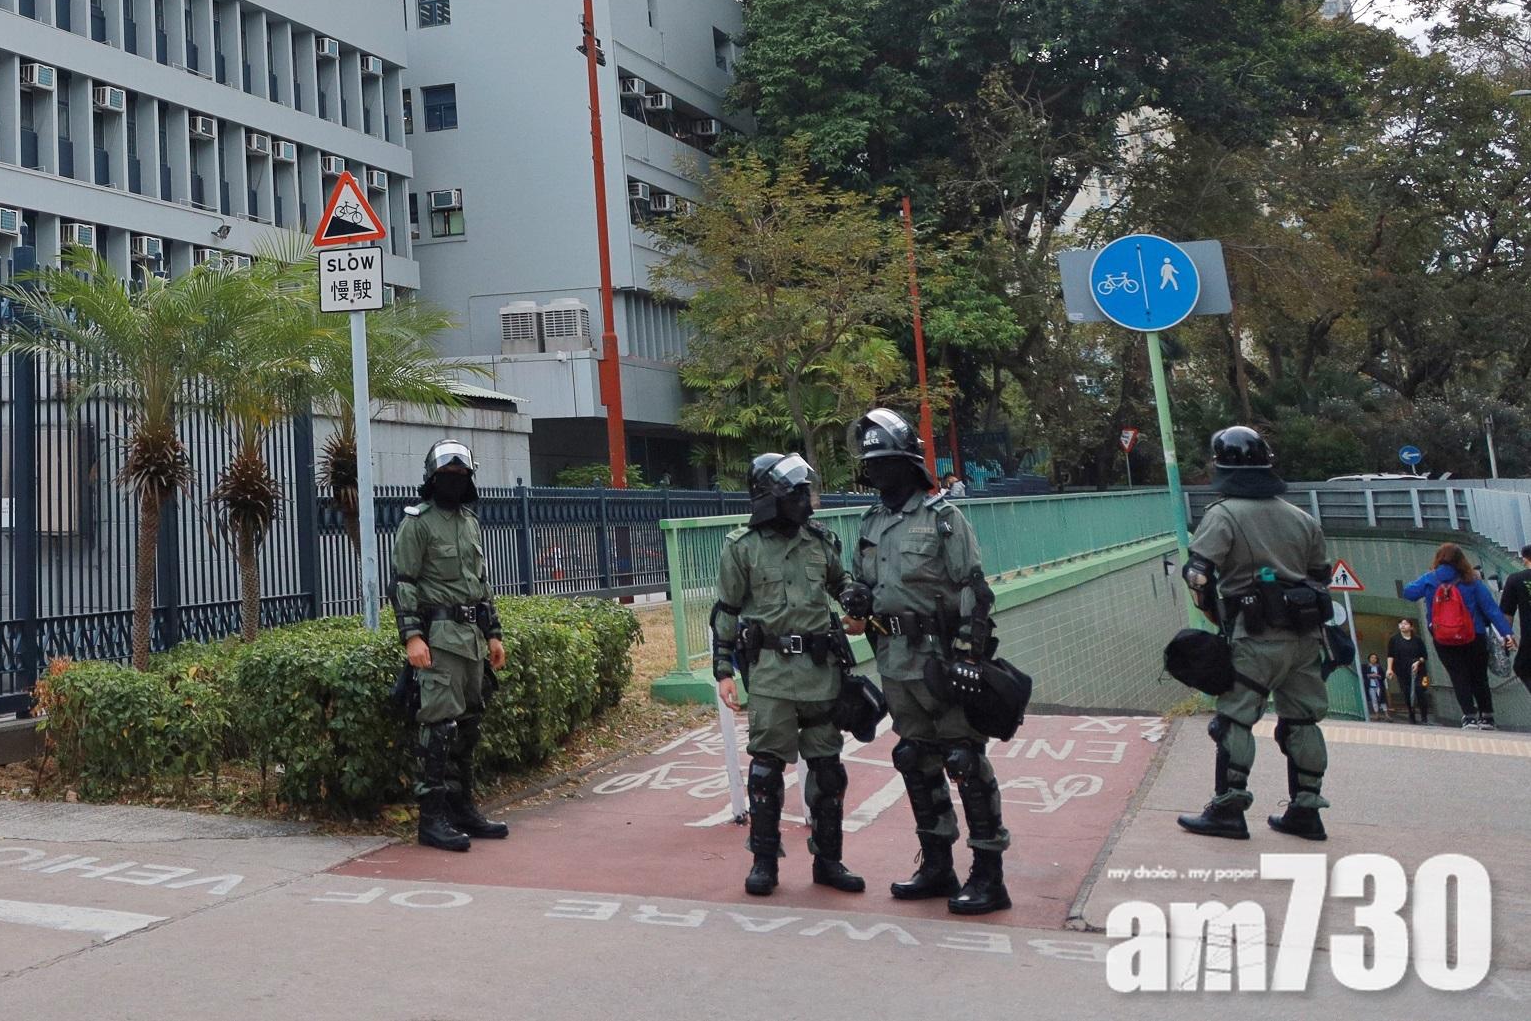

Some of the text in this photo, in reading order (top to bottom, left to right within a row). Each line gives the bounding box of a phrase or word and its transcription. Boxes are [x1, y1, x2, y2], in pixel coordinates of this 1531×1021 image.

[327, 255, 374, 272] SLOW
[331, 279, 372, 302] 慢駛
[309, 887, 1110, 963] BEWARE OF
